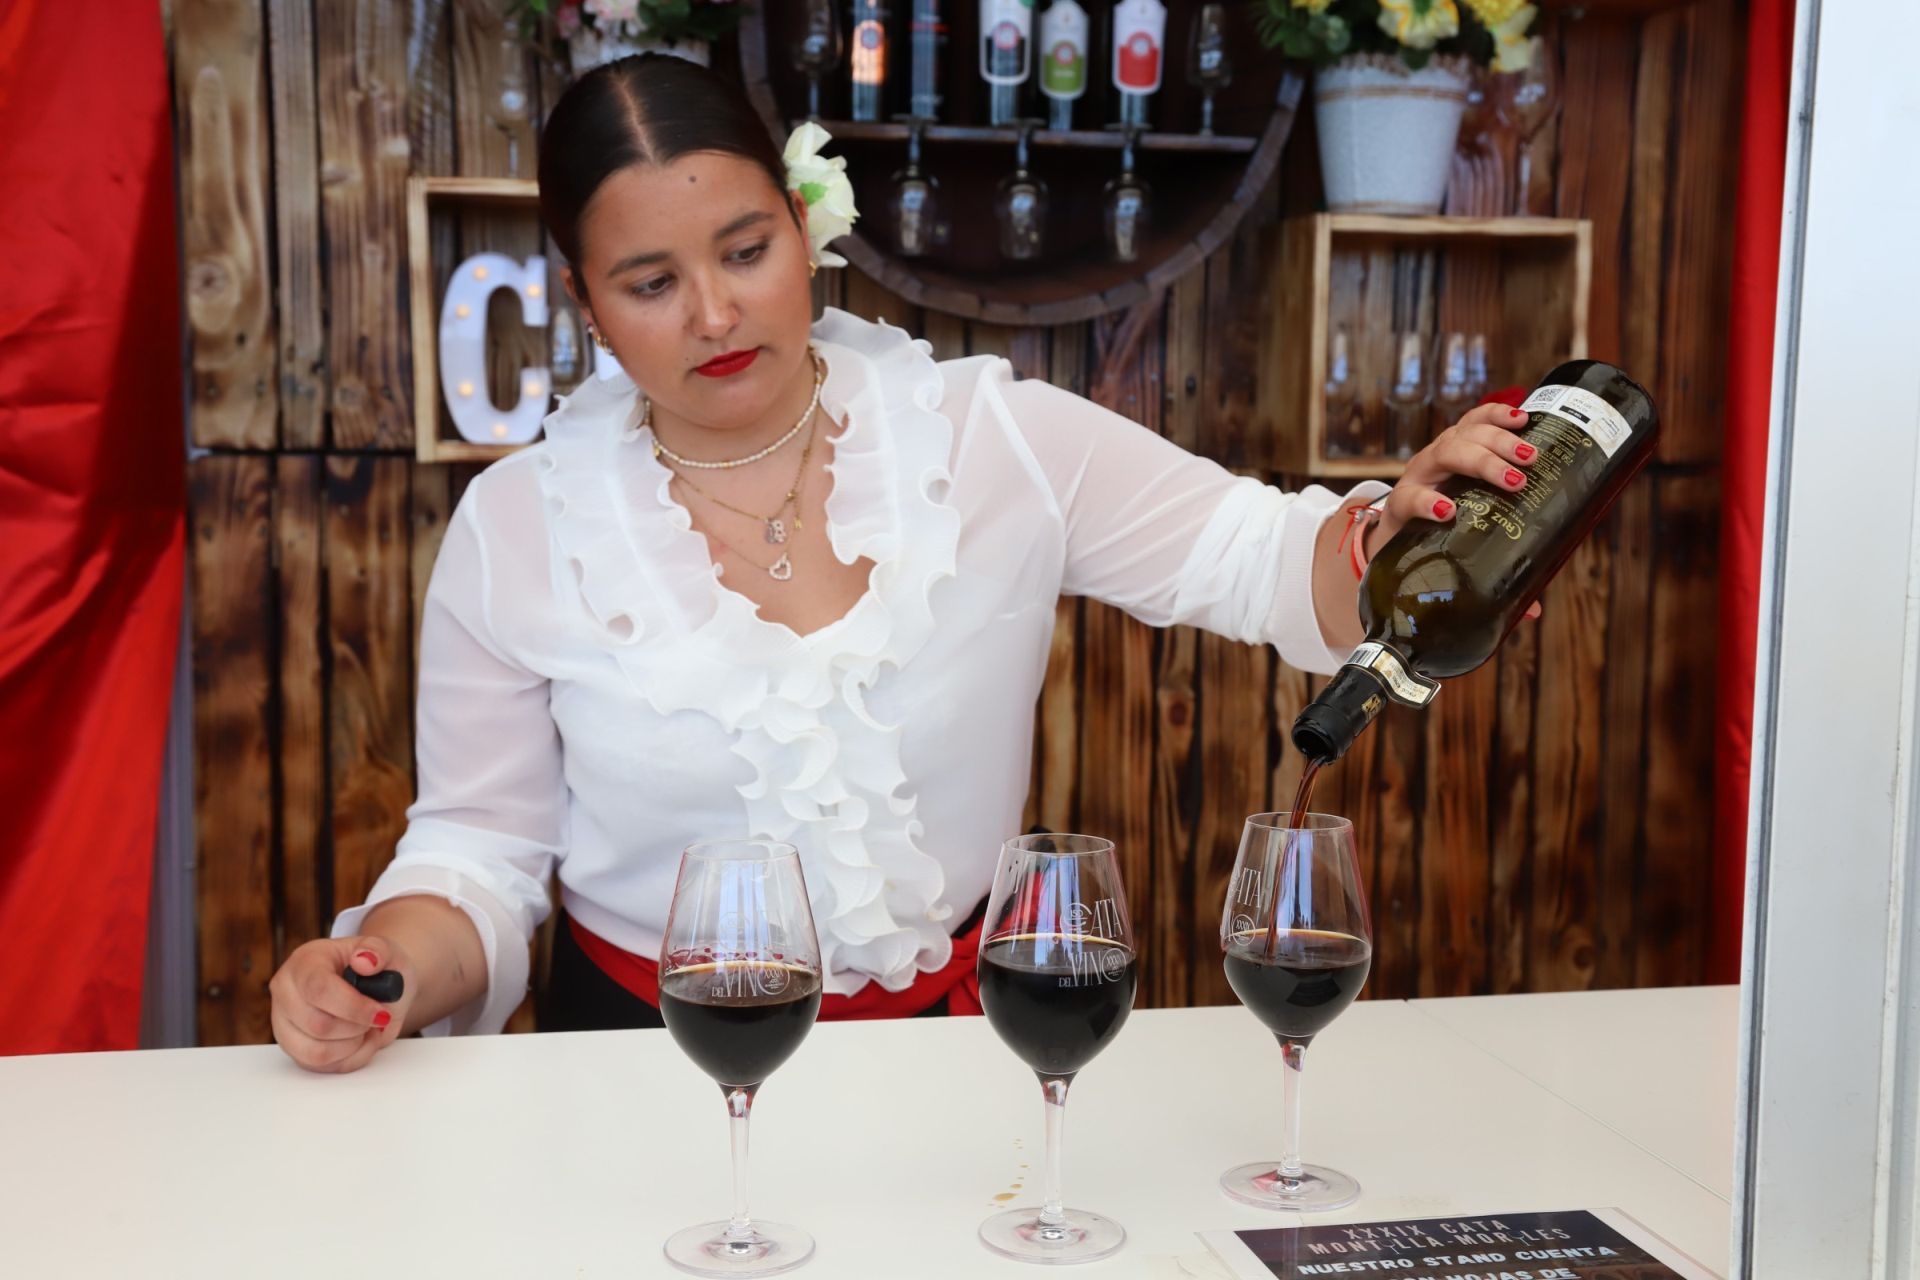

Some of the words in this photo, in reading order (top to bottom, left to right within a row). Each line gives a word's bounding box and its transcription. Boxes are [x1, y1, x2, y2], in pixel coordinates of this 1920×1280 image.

[1467, 514, 1490, 532] PX
[1490, 511, 1522, 540] CRUZ
[1232, 866, 1261, 908] ATA
[1060, 898, 1123, 942] CATA
[724, 963, 790, 998] VINO
[1071, 948, 1126, 988] VINO
[1344, 1223, 1425, 1240] XXXIX
[1440, 1219, 1510, 1235] CATA
[1297, 1258, 1414, 1275] NUESTRO
[1423, 1252, 1506, 1267] STAND
[1515, 1246, 1619, 1261] CUENTA
[1539, 1267, 1577, 1279] DE
